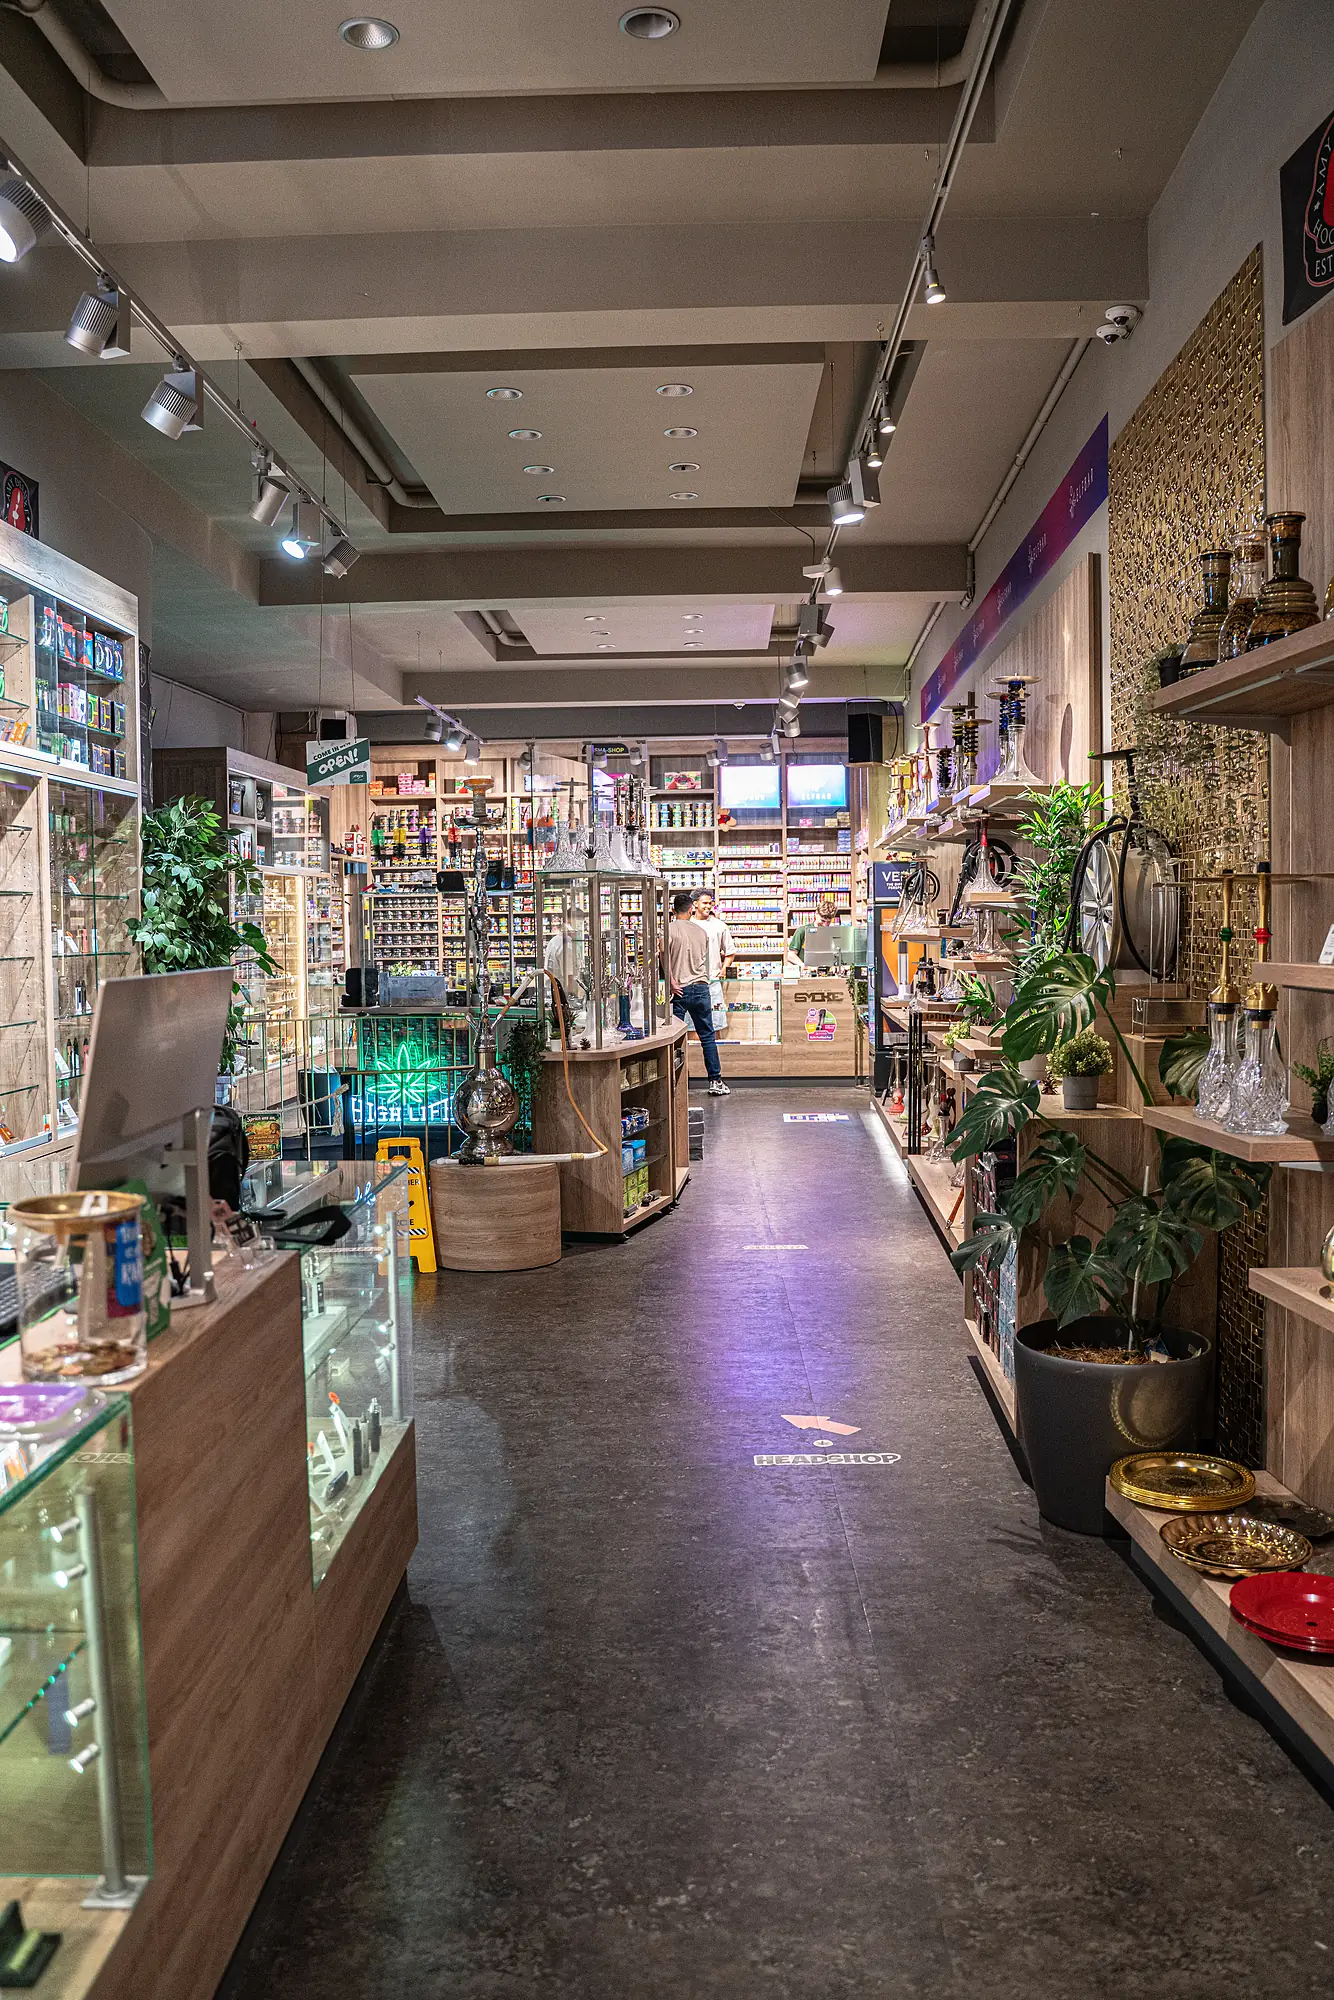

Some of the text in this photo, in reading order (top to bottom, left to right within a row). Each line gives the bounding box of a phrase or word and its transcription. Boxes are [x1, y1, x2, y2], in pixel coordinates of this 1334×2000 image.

[1317, 136, 1331, 195] AMY
[1076, 468, 1094, 502] ELFBAR
[313, 749, 331, 760] COME
[318, 748, 358, 774] OPEN!
[351, 1097, 402, 1122] HIGH
[755, 1454, 901, 1466] HEADSHOP
